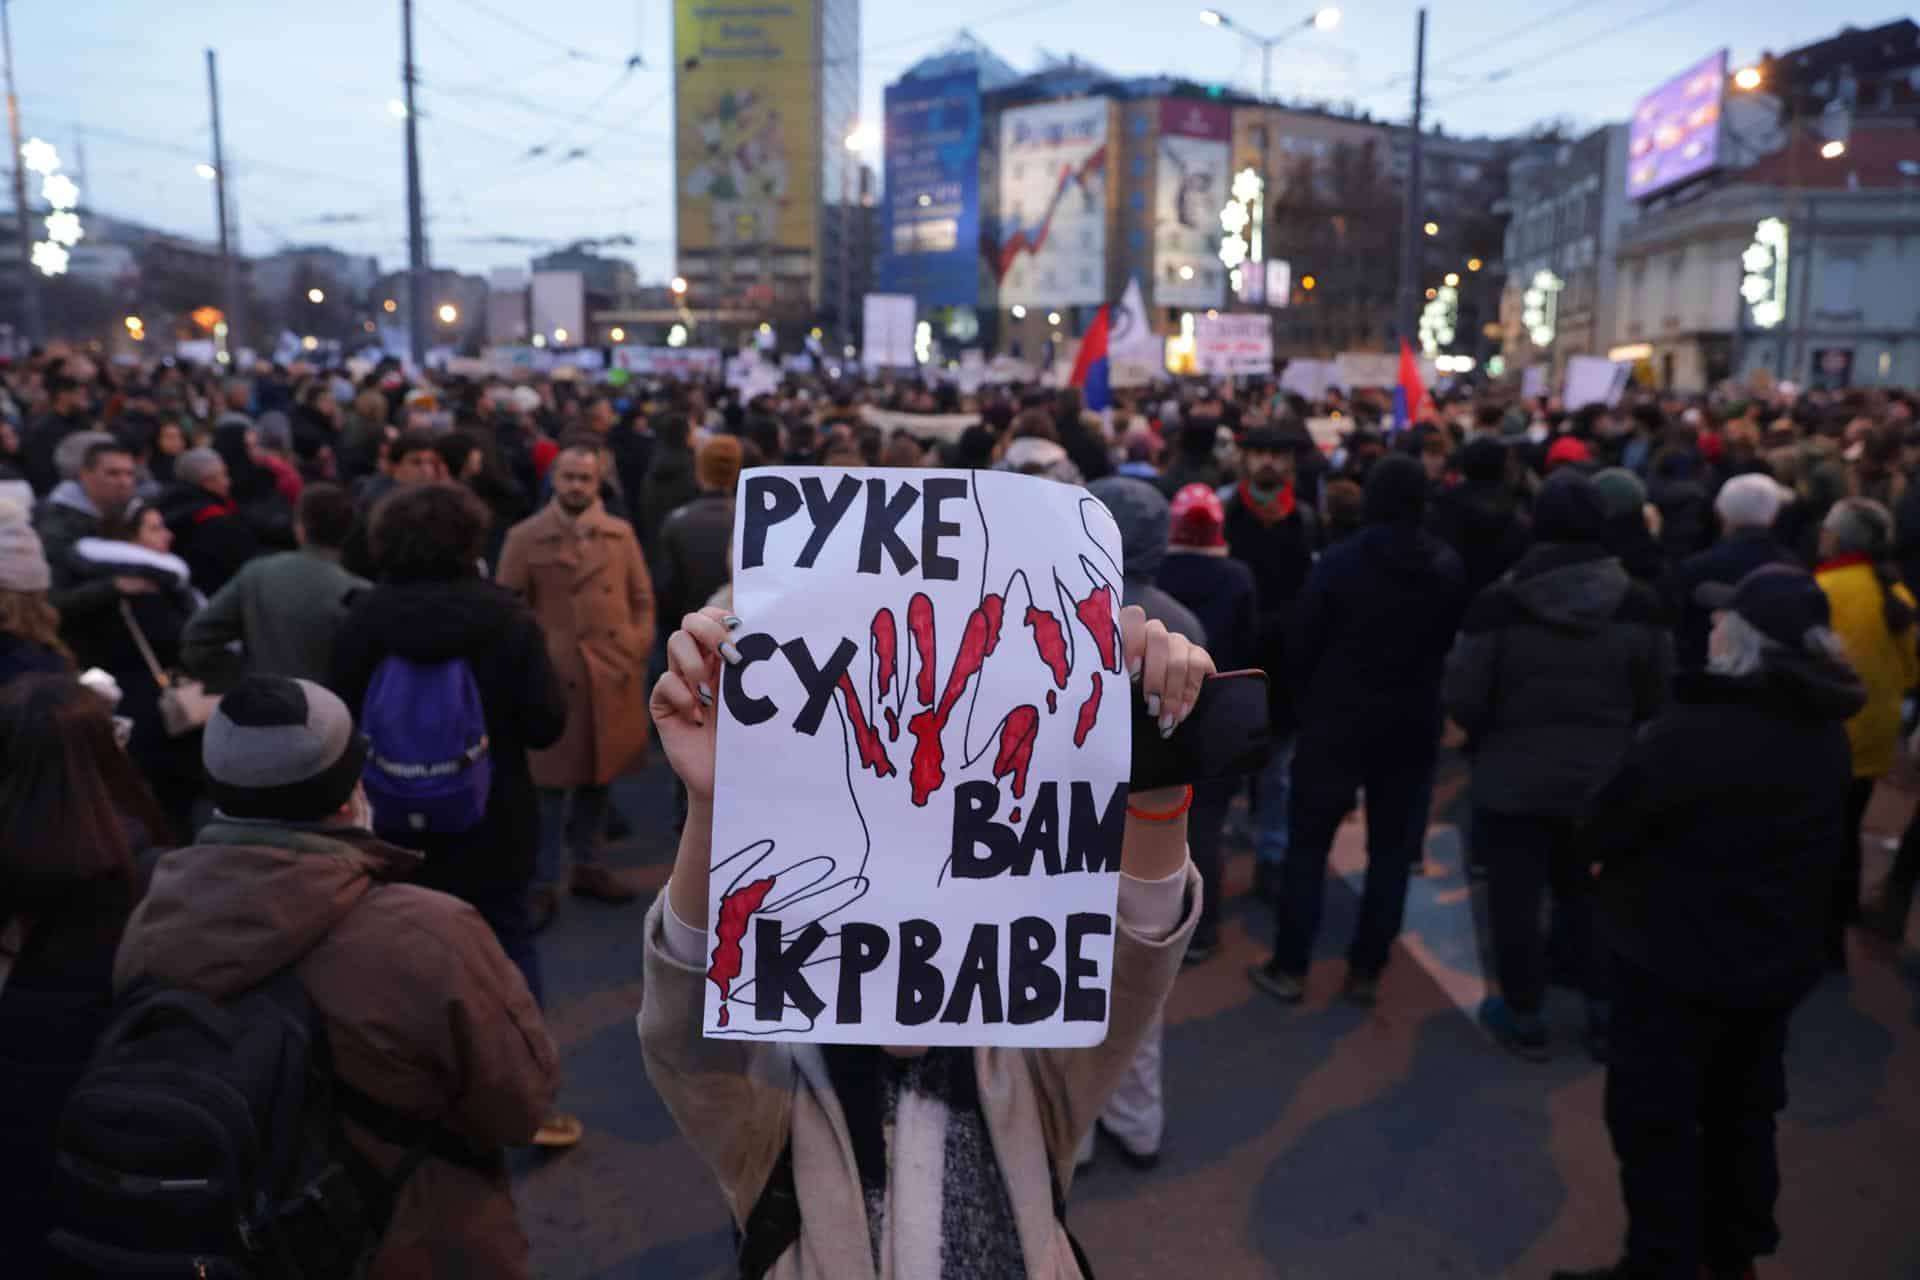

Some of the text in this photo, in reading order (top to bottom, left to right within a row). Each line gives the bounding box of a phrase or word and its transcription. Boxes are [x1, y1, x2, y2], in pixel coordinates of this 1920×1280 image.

[742, 475, 968, 580] РУКЕ
[722, 632, 858, 736] СУ
[951, 780, 1130, 878] ВАМ
[755, 912, 1111, 1026] КРВАВЕ
